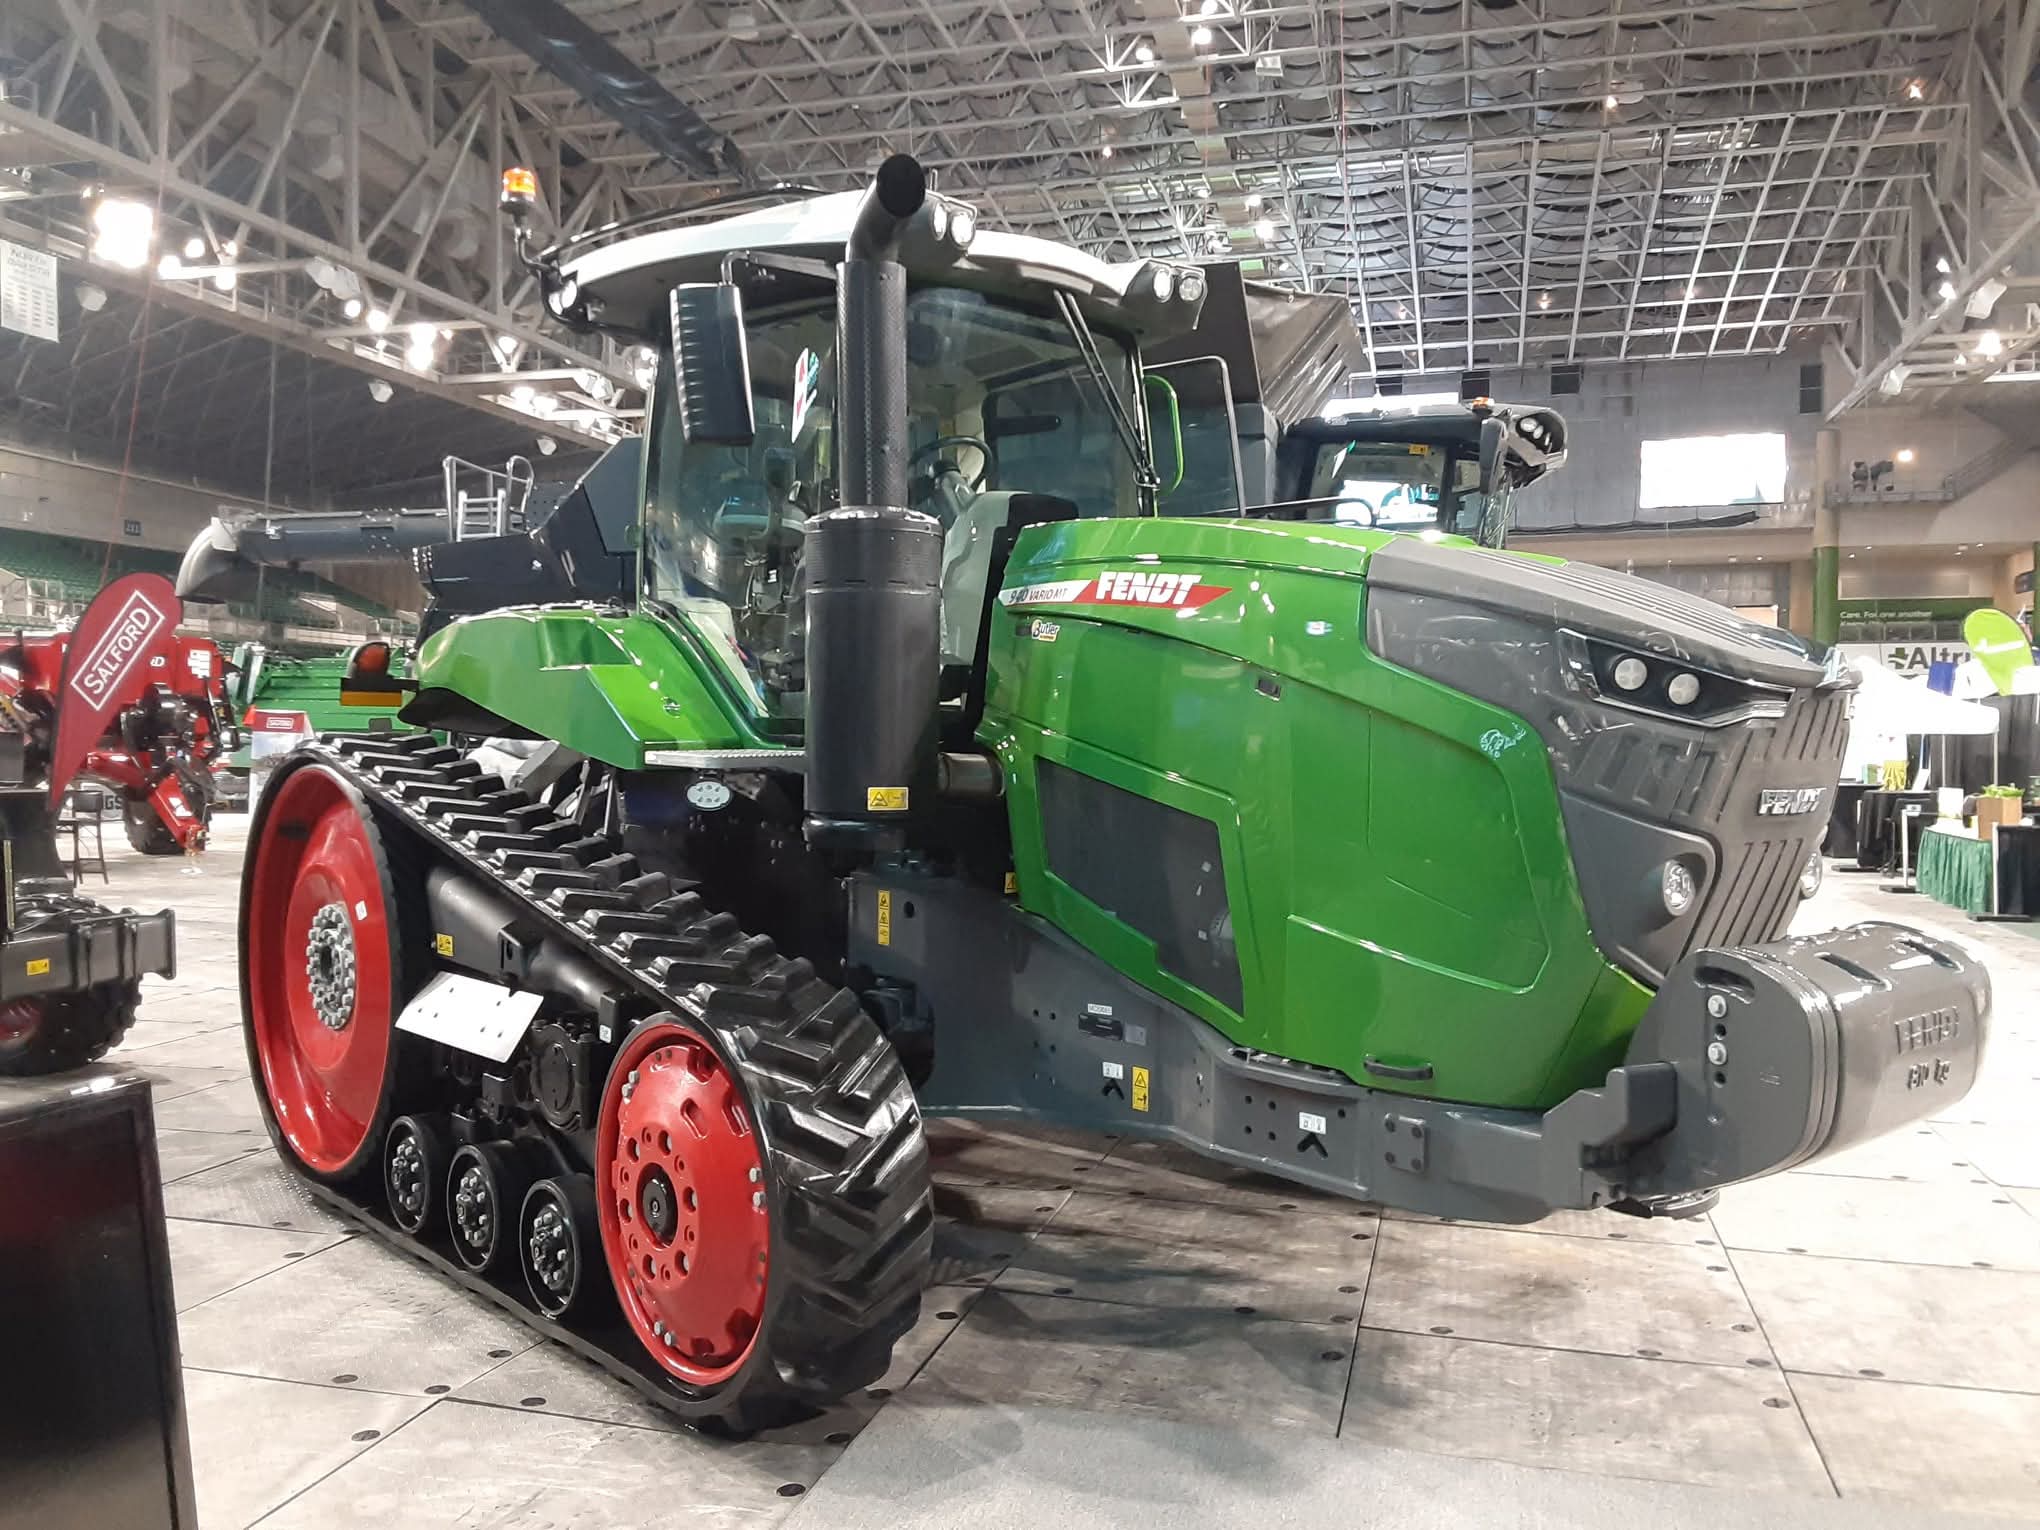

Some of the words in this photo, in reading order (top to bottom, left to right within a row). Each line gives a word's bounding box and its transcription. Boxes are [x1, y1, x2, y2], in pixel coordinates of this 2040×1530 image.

[1029, 588, 1053, 601] VARIO
[1096, 571, 1202, 605] FENDT
[83, 608, 151, 695] SALFORD
[1759, 787, 1827, 815] FENDT
